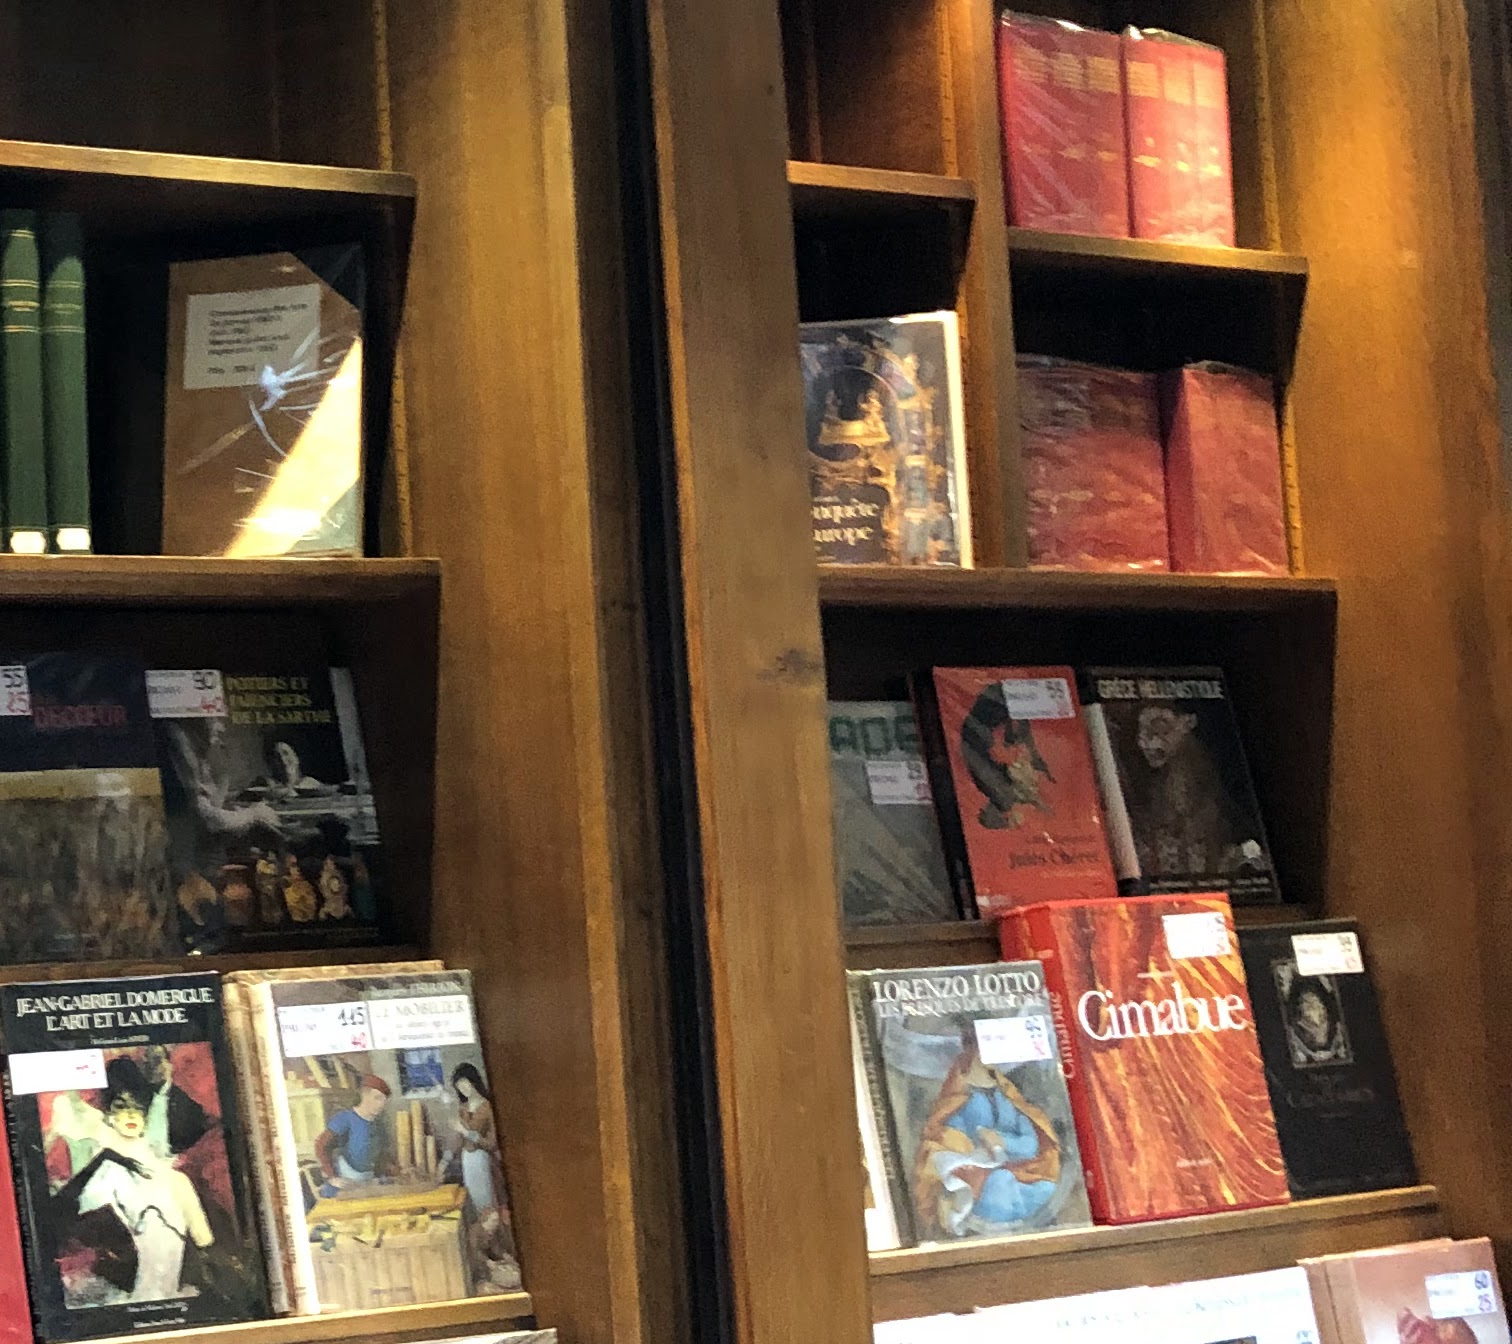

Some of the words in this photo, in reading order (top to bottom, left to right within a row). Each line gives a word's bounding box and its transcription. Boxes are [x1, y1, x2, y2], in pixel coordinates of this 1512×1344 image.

[873, 975, 969, 1003] LORENZO
[973, 970, 1040, 996] LOTTO
[93, 1012, 115, 1028] ET
[117, 1009, 143, 1027] LA
[141, 1007, 188, 1024] MODE
[1077, 981, 1246, 1040] Cimabue
